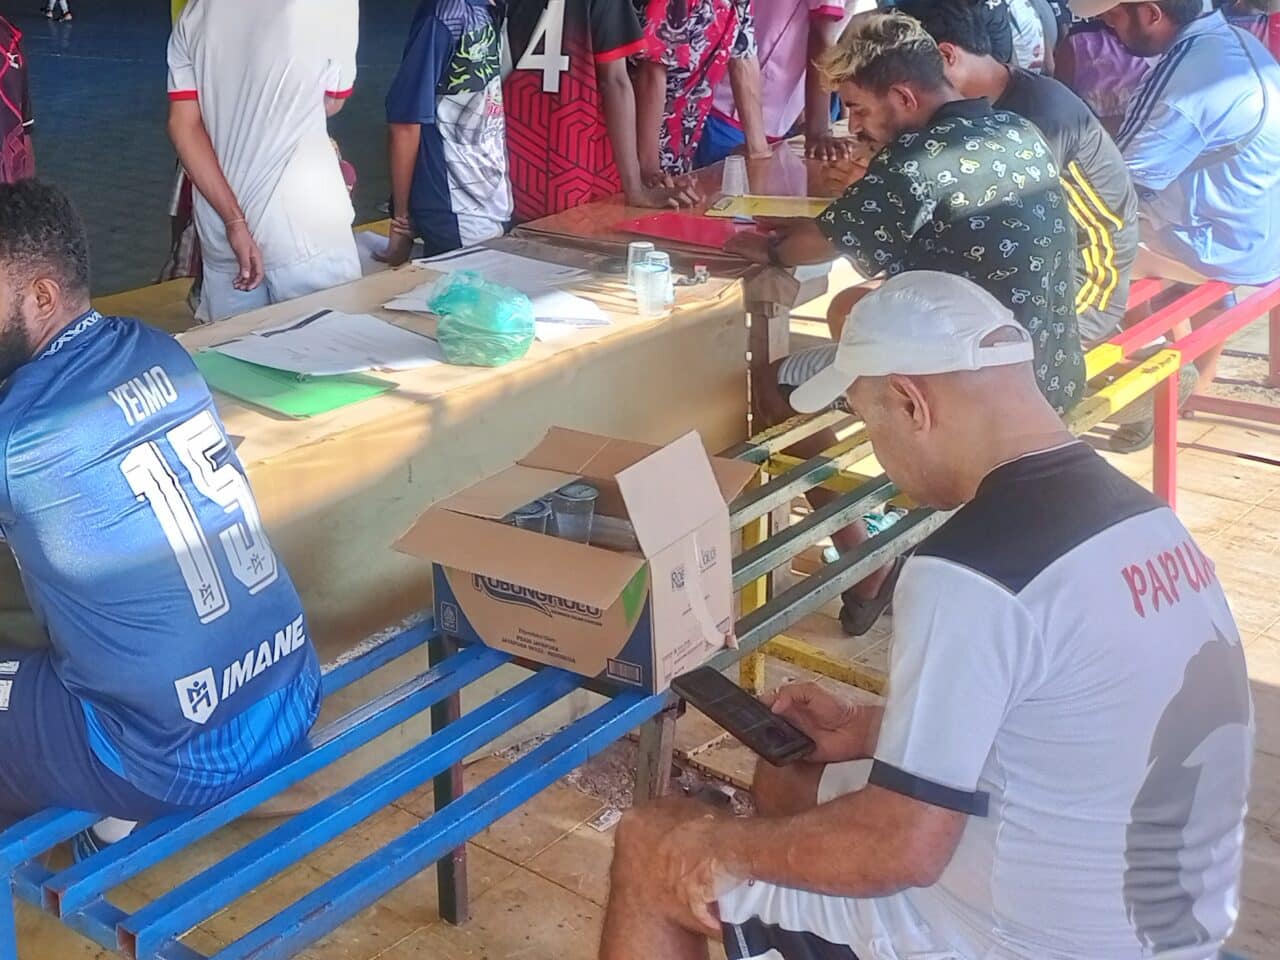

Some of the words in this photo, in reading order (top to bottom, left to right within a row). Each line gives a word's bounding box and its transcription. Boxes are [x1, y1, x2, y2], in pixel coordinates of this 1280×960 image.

[515, 0, 570, 93] 4
[108, 366, 179, 426] YEIMO
[119, 409, 279, 625] 15
[220, 613, 307, 701] IMANE
